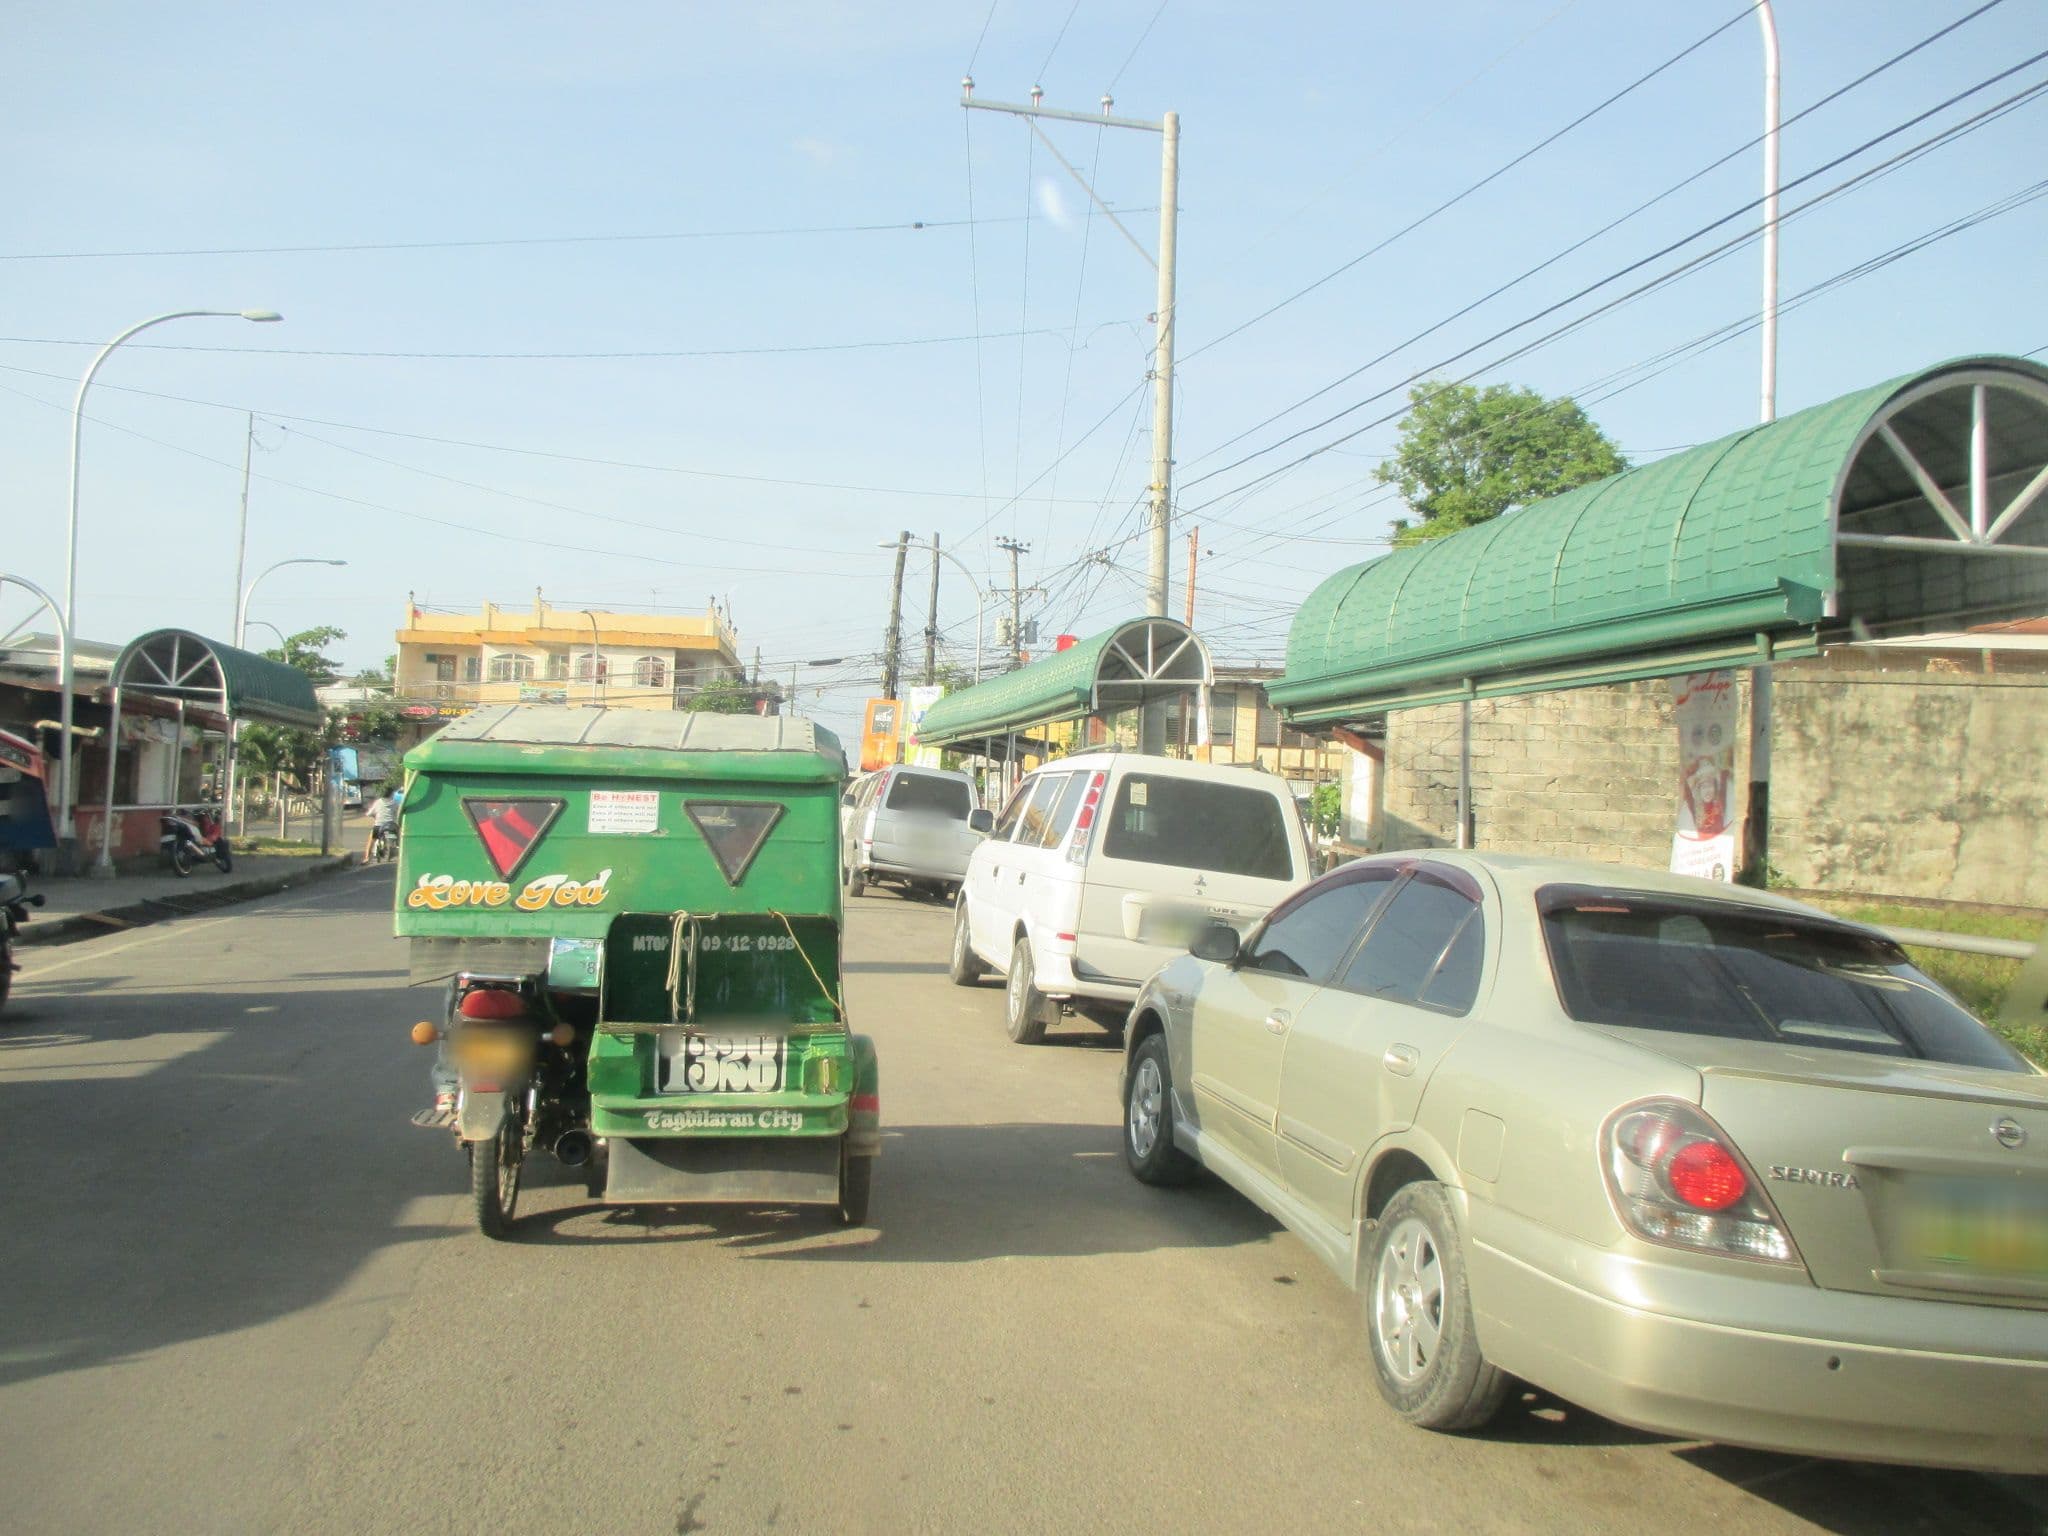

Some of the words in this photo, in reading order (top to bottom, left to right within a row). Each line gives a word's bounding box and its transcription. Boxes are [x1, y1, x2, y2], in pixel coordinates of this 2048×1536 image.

[408, 872, 511, 910] Love
[515, 868, 613, 911] God
[643, 1110, 755, 1131] Tagbilaran
[758, 1110, 803, 1131] City
[1768, 1165, 1861, 1191] SENTRA
